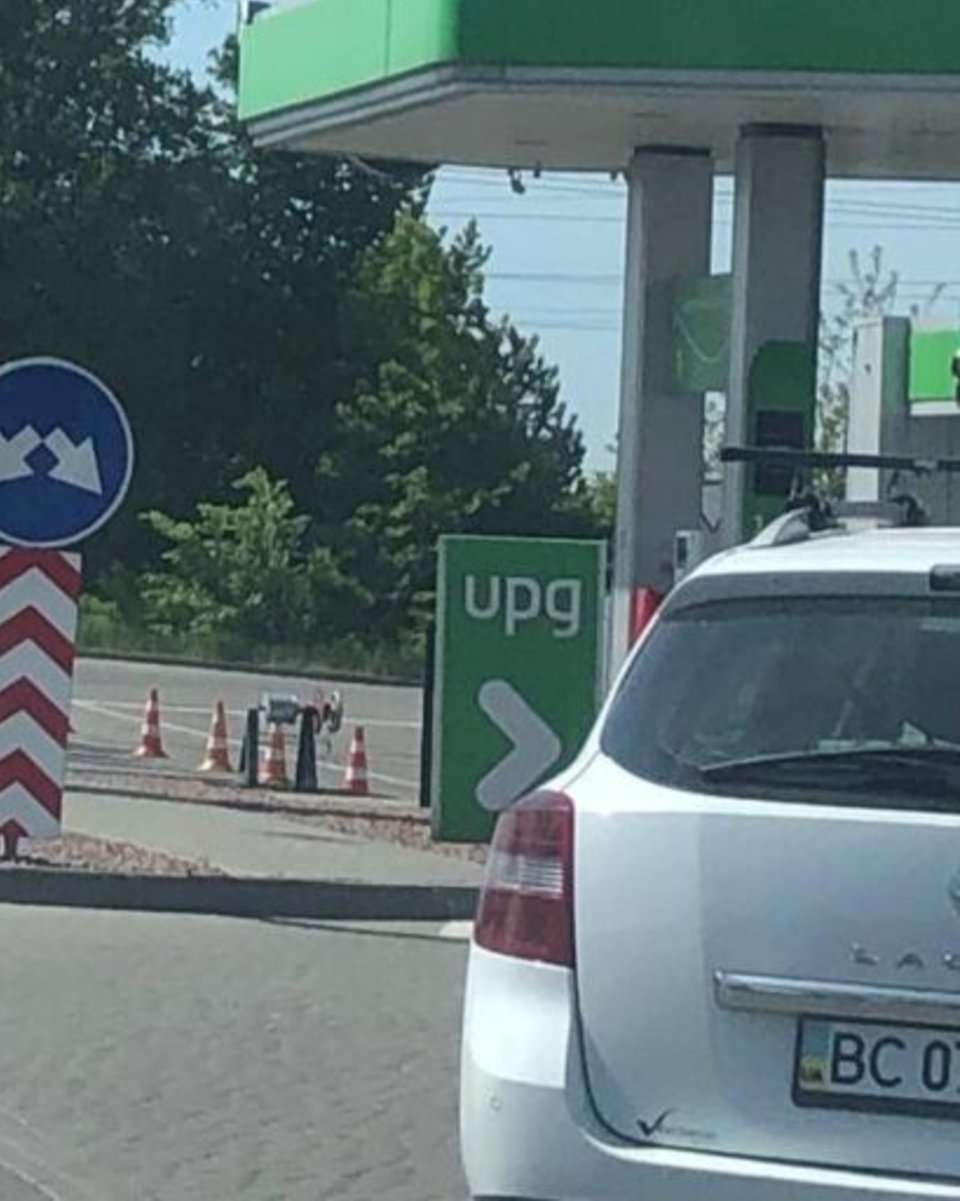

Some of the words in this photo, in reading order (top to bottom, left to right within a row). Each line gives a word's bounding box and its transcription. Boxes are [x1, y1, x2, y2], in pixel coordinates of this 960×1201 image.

[465, 574, 581, 638] upg
[831, 1031, 906, 1088] BC
[922, 1038, 960, 1093] 0
